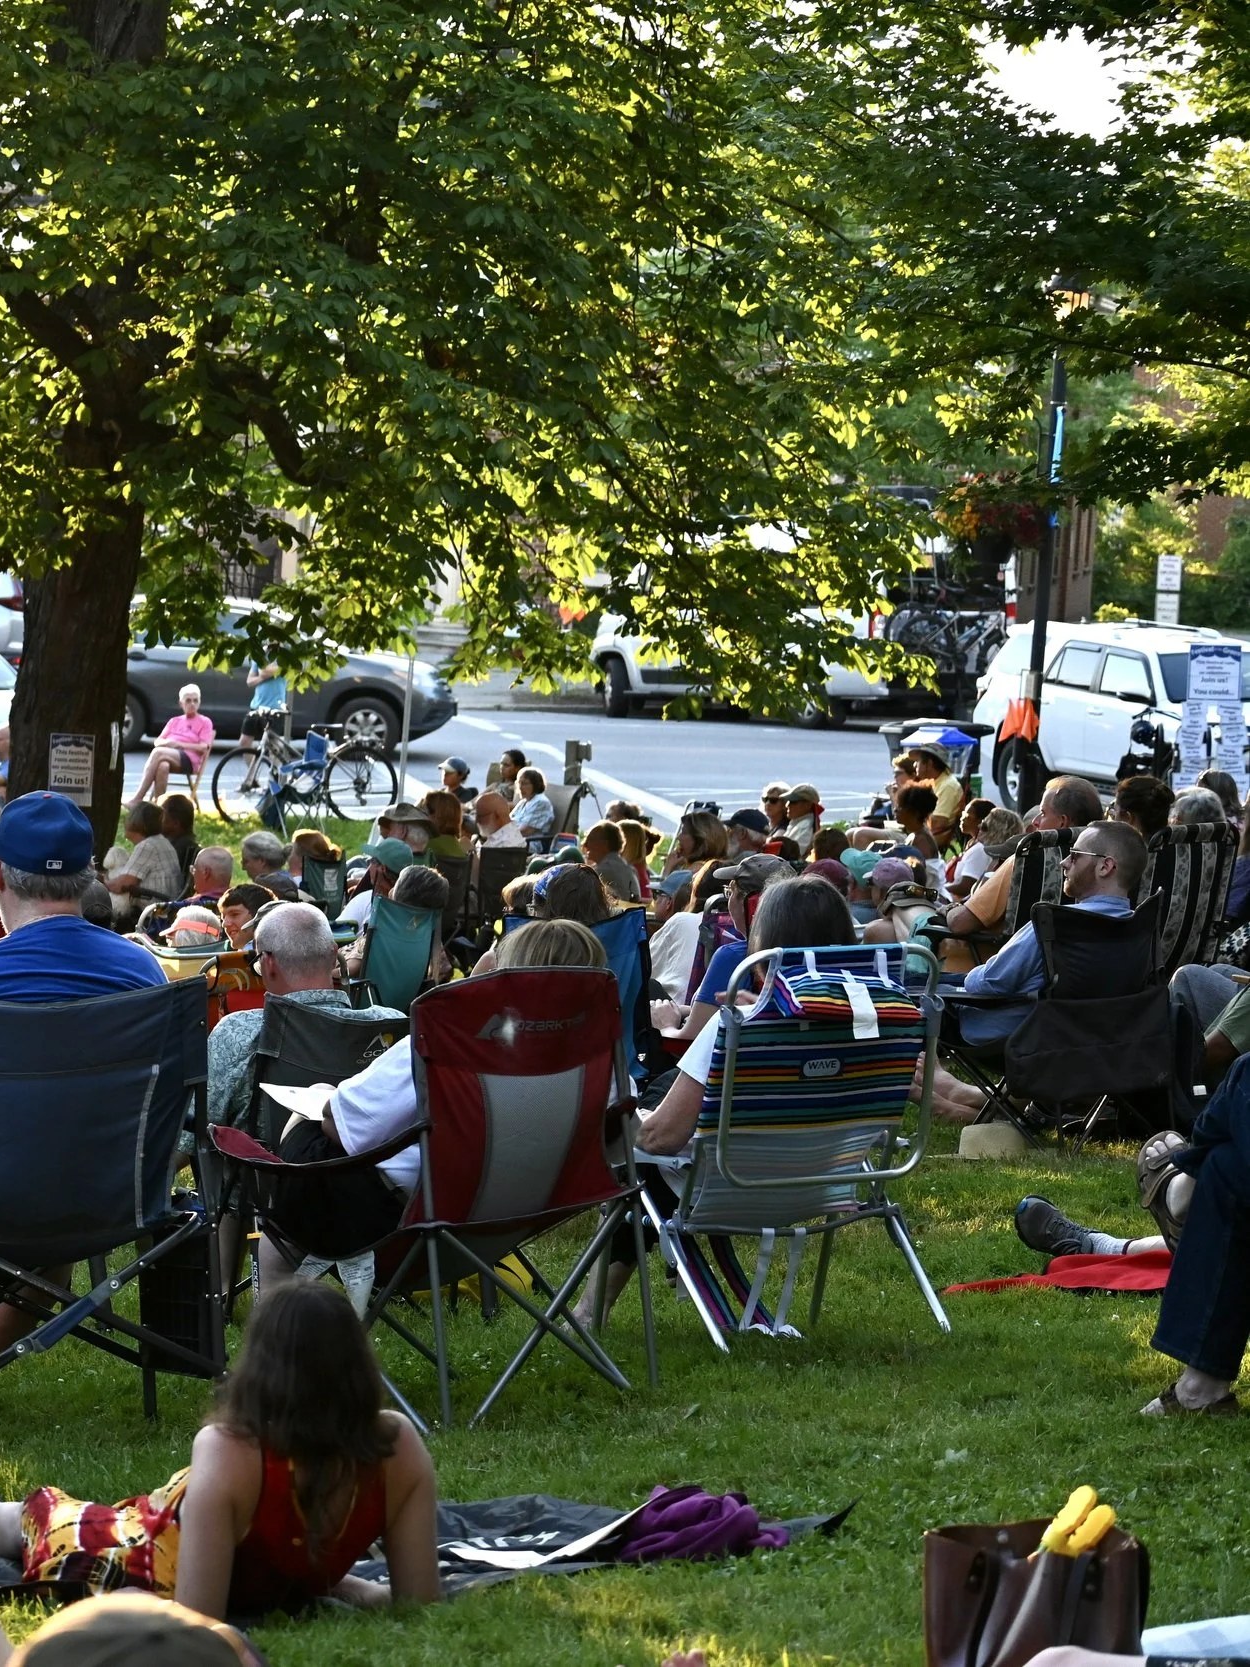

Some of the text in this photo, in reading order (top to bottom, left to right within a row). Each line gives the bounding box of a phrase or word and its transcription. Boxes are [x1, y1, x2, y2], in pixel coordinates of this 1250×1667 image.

[53, 775, 89, 785] Join us!
[807, 1060, 837, 1070] WAVE
